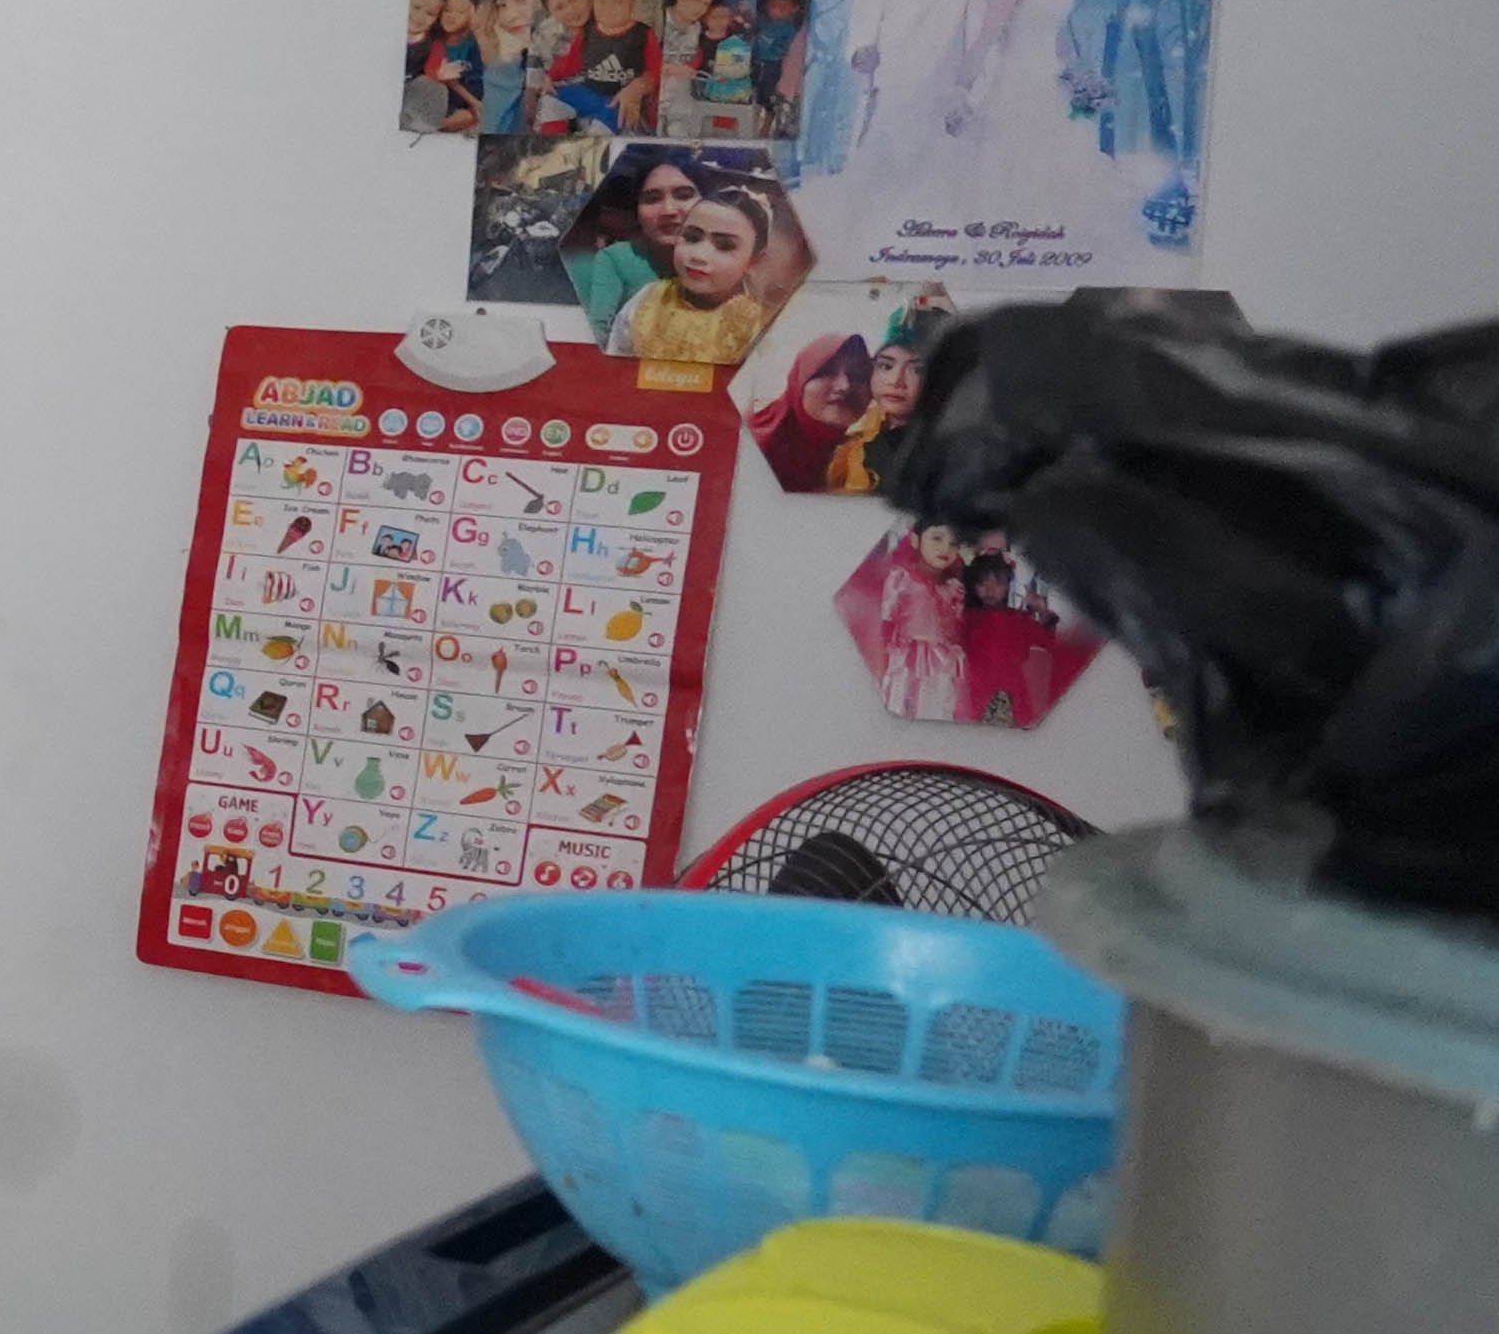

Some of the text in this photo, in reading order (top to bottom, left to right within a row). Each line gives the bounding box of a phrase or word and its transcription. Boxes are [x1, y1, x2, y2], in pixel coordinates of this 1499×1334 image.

[260, 380, 356, 408] ABJAD
[218, 796, 259, 812] GAME
[559, 840, 611, 859] MUSIC
[269, 865, 282, 888] 1
[308, 870, 325, 894] 2
[347, 875, 365, 899] 3
[386, 882, 405, 905] 4
[427, 887, 448, 911] 5
